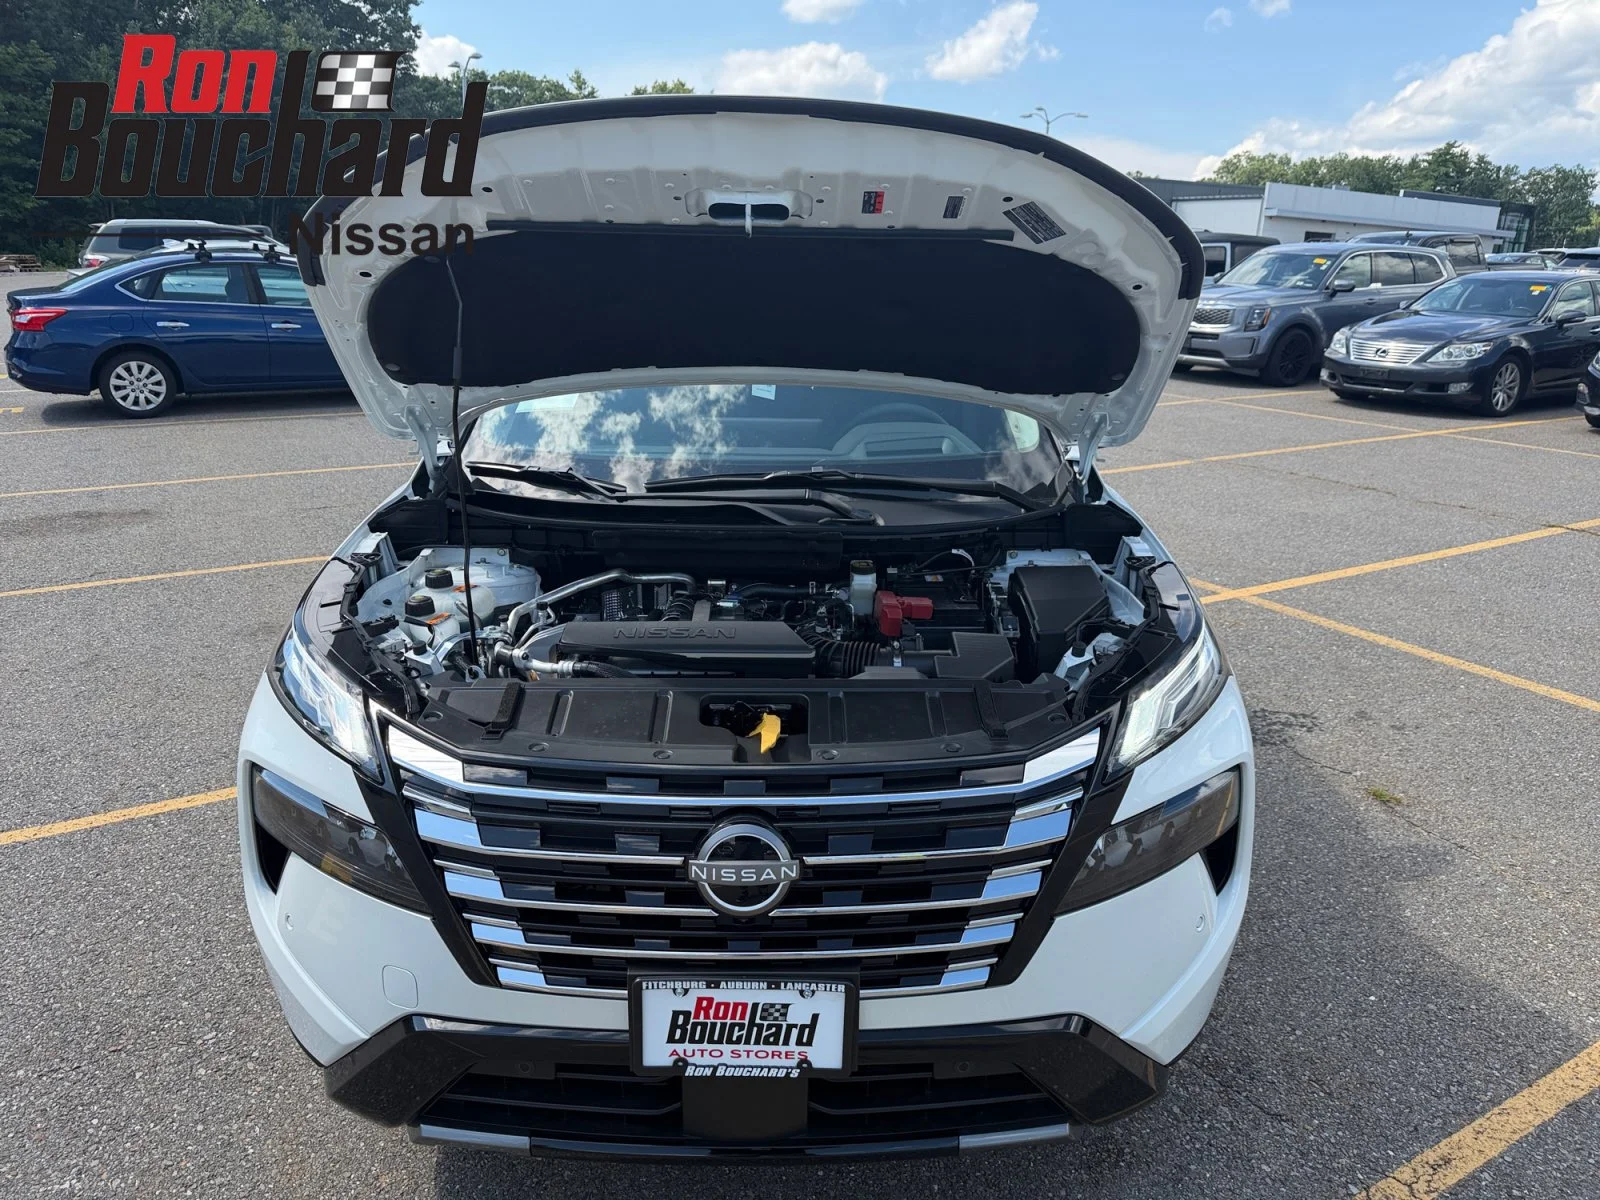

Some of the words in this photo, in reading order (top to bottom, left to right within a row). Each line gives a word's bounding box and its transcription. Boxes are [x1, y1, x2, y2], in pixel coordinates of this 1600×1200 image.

[613, 627, 737, 639] NISSAN
[691, 864, 797, 882] NISSAN
[642, 981, 707, 990] FITCHBURG
[720, 981, 768, 990] AUBURN
[780, 982, 846, 993] LANCASTER
[692, 996, 749, 1021] Ron
[665, 1002, 821, 1047] Bouchard
[668, 1048, 724, 1058] AUTO
[730, 1049, 809, 1060] STORES
